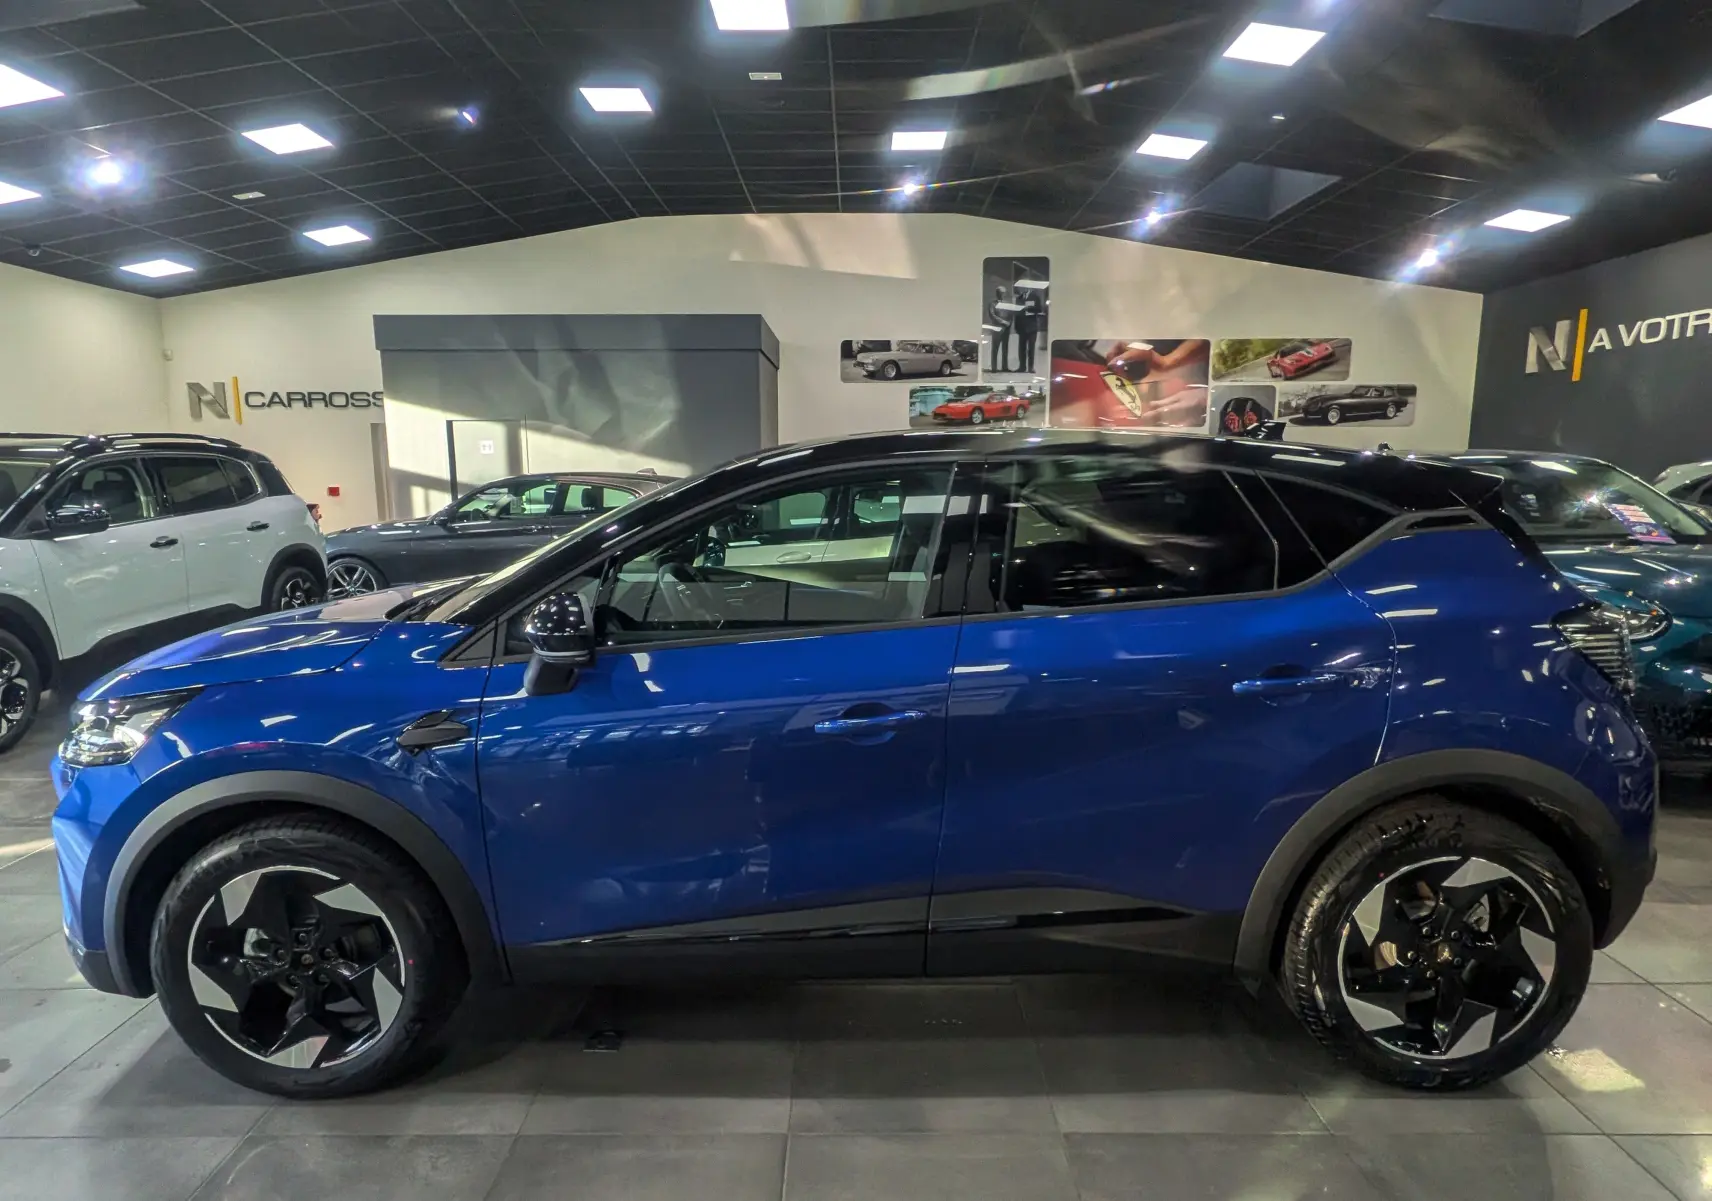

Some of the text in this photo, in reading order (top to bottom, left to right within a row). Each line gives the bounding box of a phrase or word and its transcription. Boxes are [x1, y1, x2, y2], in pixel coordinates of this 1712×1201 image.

[1525, 320, 1571, 374] N
[1588, 328, 1612, 353] A
[186, 382, 230, 419] N
